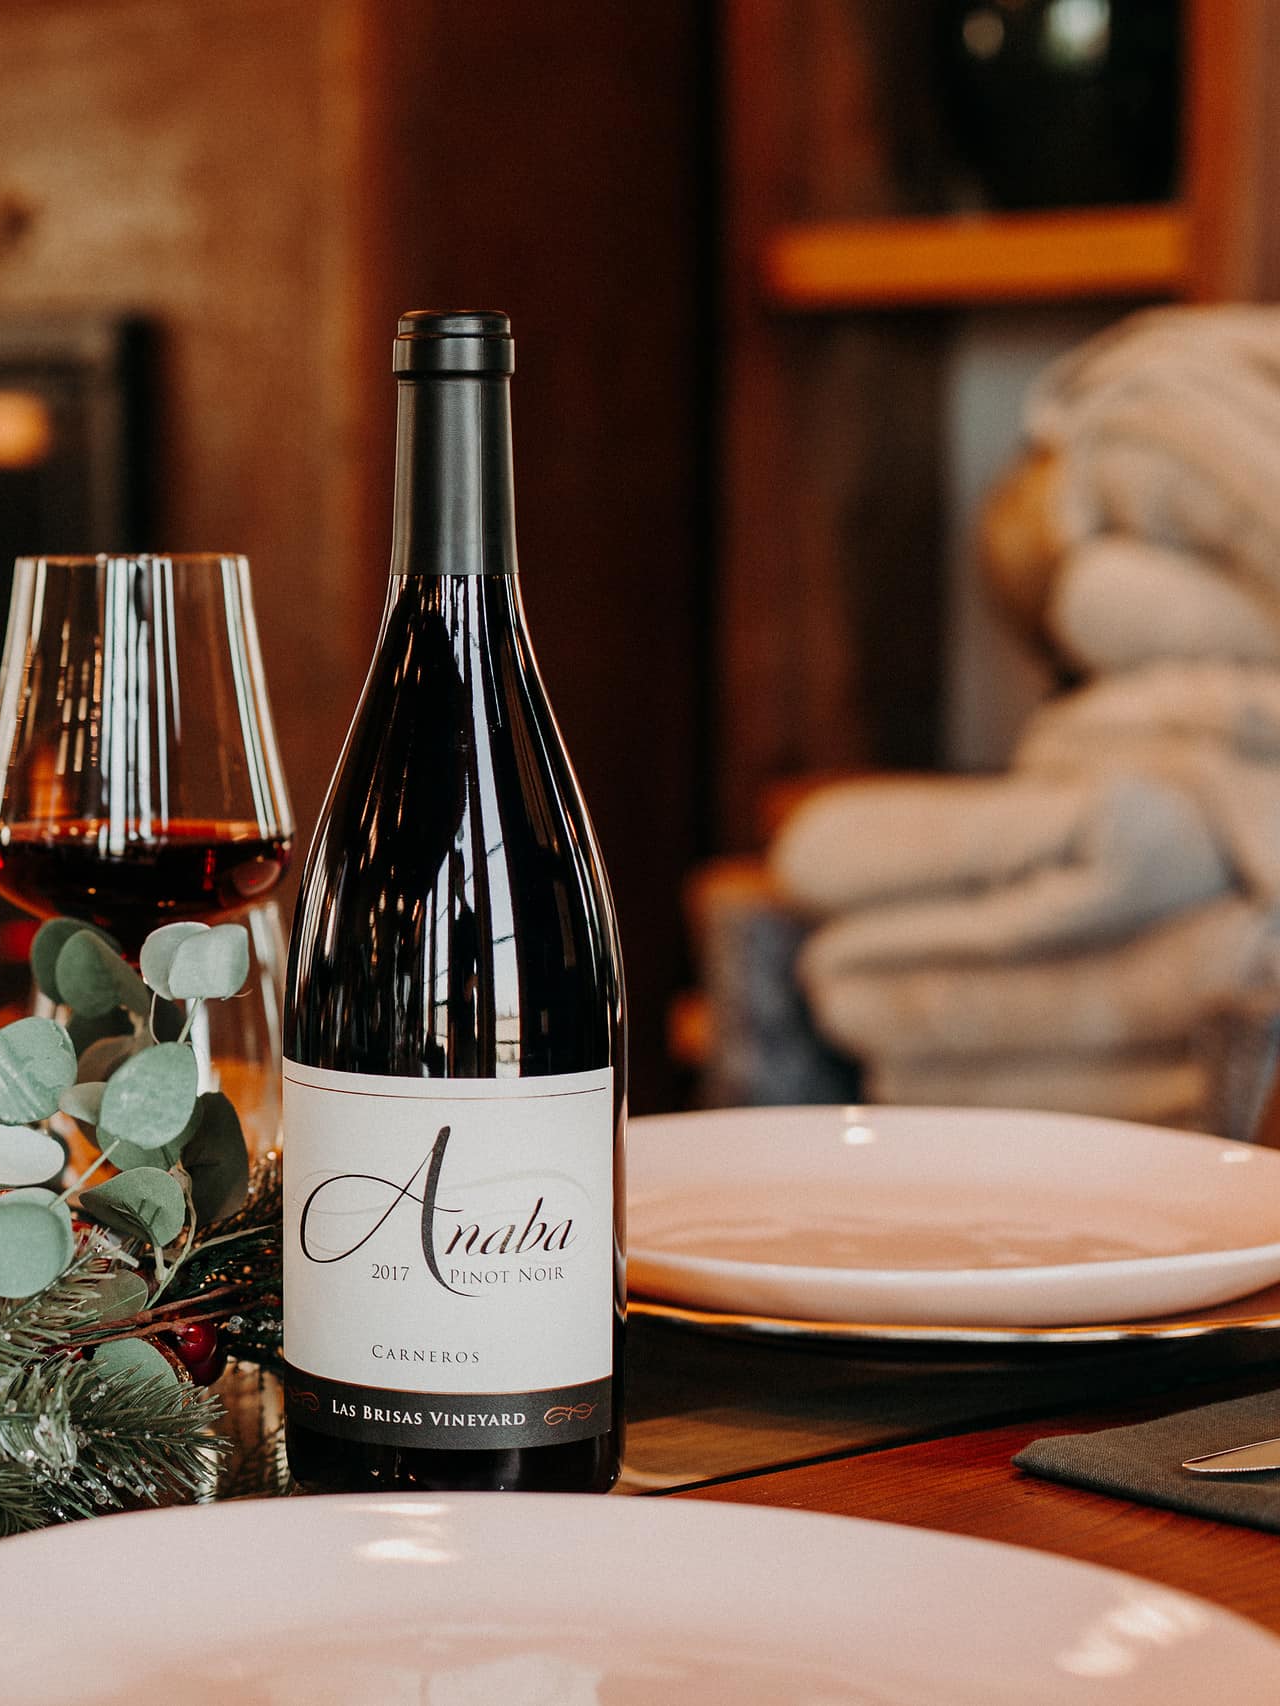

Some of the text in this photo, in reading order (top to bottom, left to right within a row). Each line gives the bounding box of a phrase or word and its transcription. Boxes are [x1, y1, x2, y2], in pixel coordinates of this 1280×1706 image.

[299, 1125, 578, 1298] Anaba
[371, 1263, 566, 1285] 2017 PINOT NOIR
[371, 1344, 481, 1364] CARNEROS
[332, 1399, 526, 1427] LAS BRISAS VINEYARD
